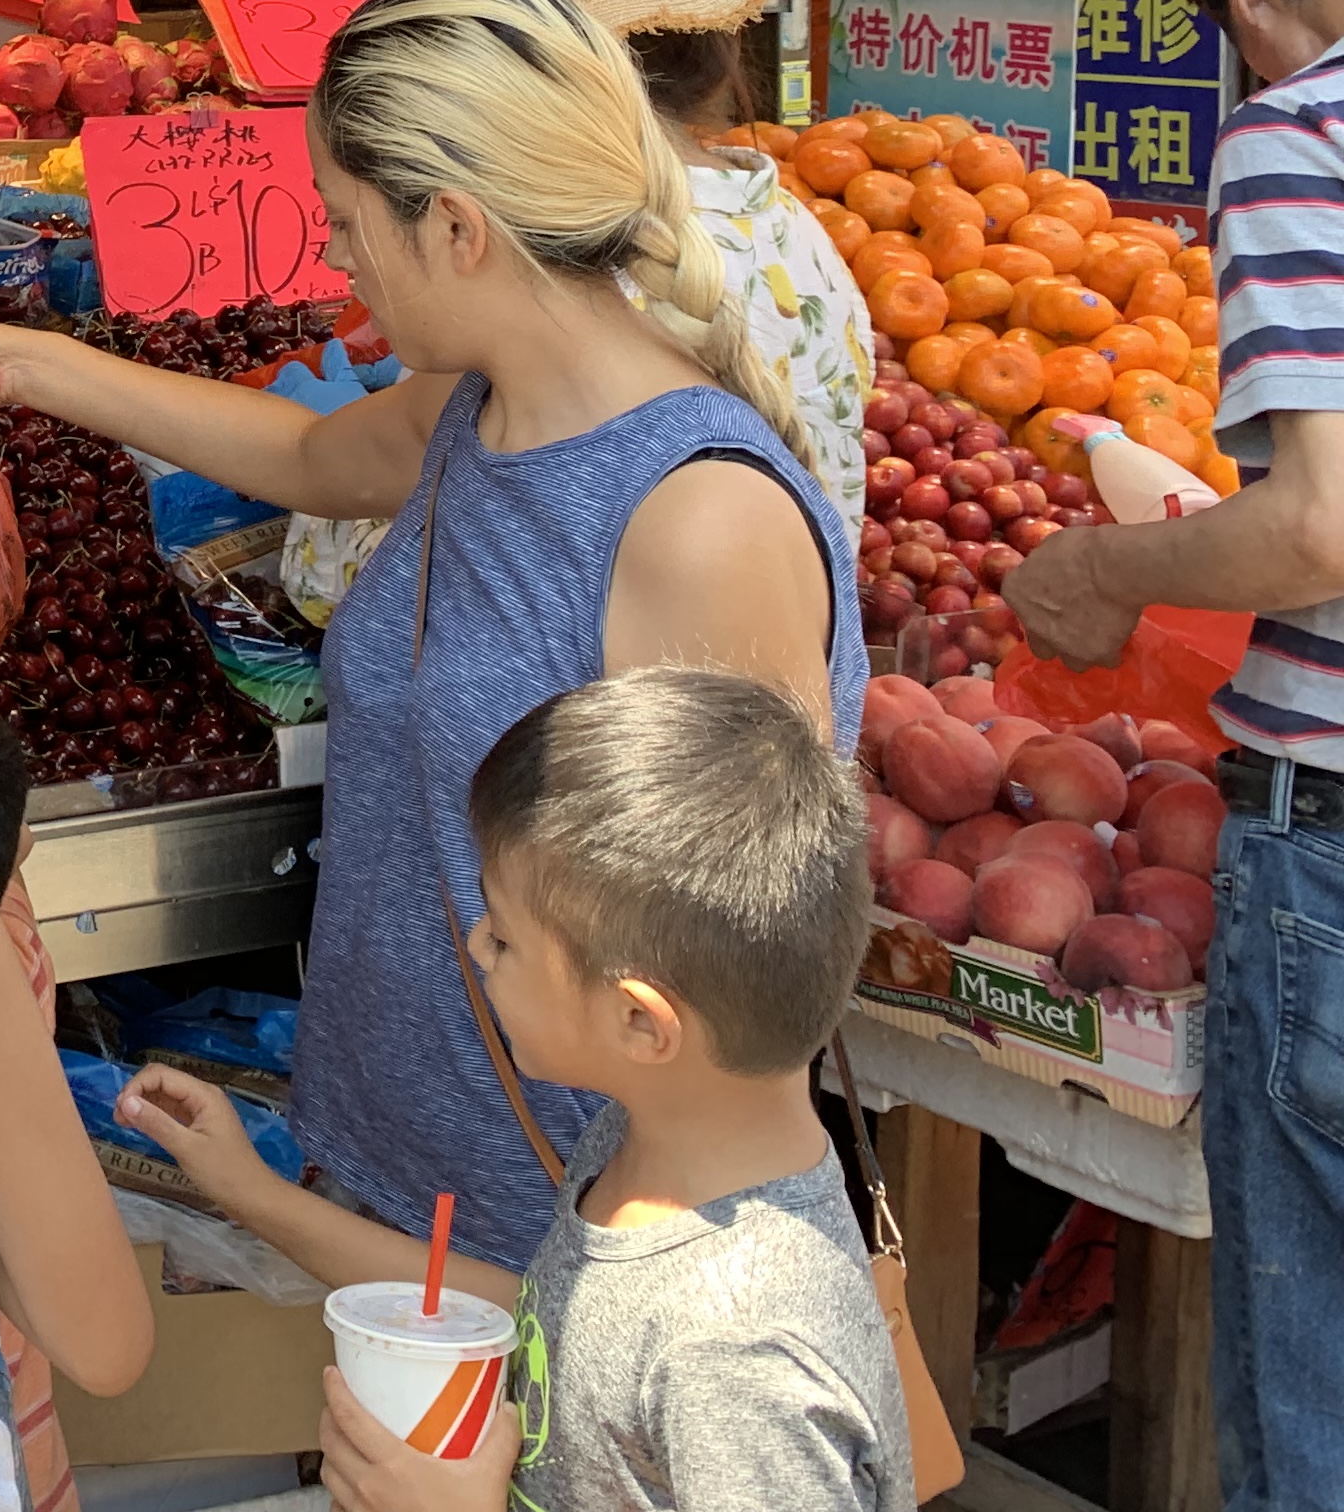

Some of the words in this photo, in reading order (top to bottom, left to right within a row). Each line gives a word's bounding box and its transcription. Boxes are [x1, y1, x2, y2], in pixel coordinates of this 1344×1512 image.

[847, 6, 1056, 92] 特价机票
[1074, 102, 1196, 187] 出租
[955, 965, 1082, 1039] Market
